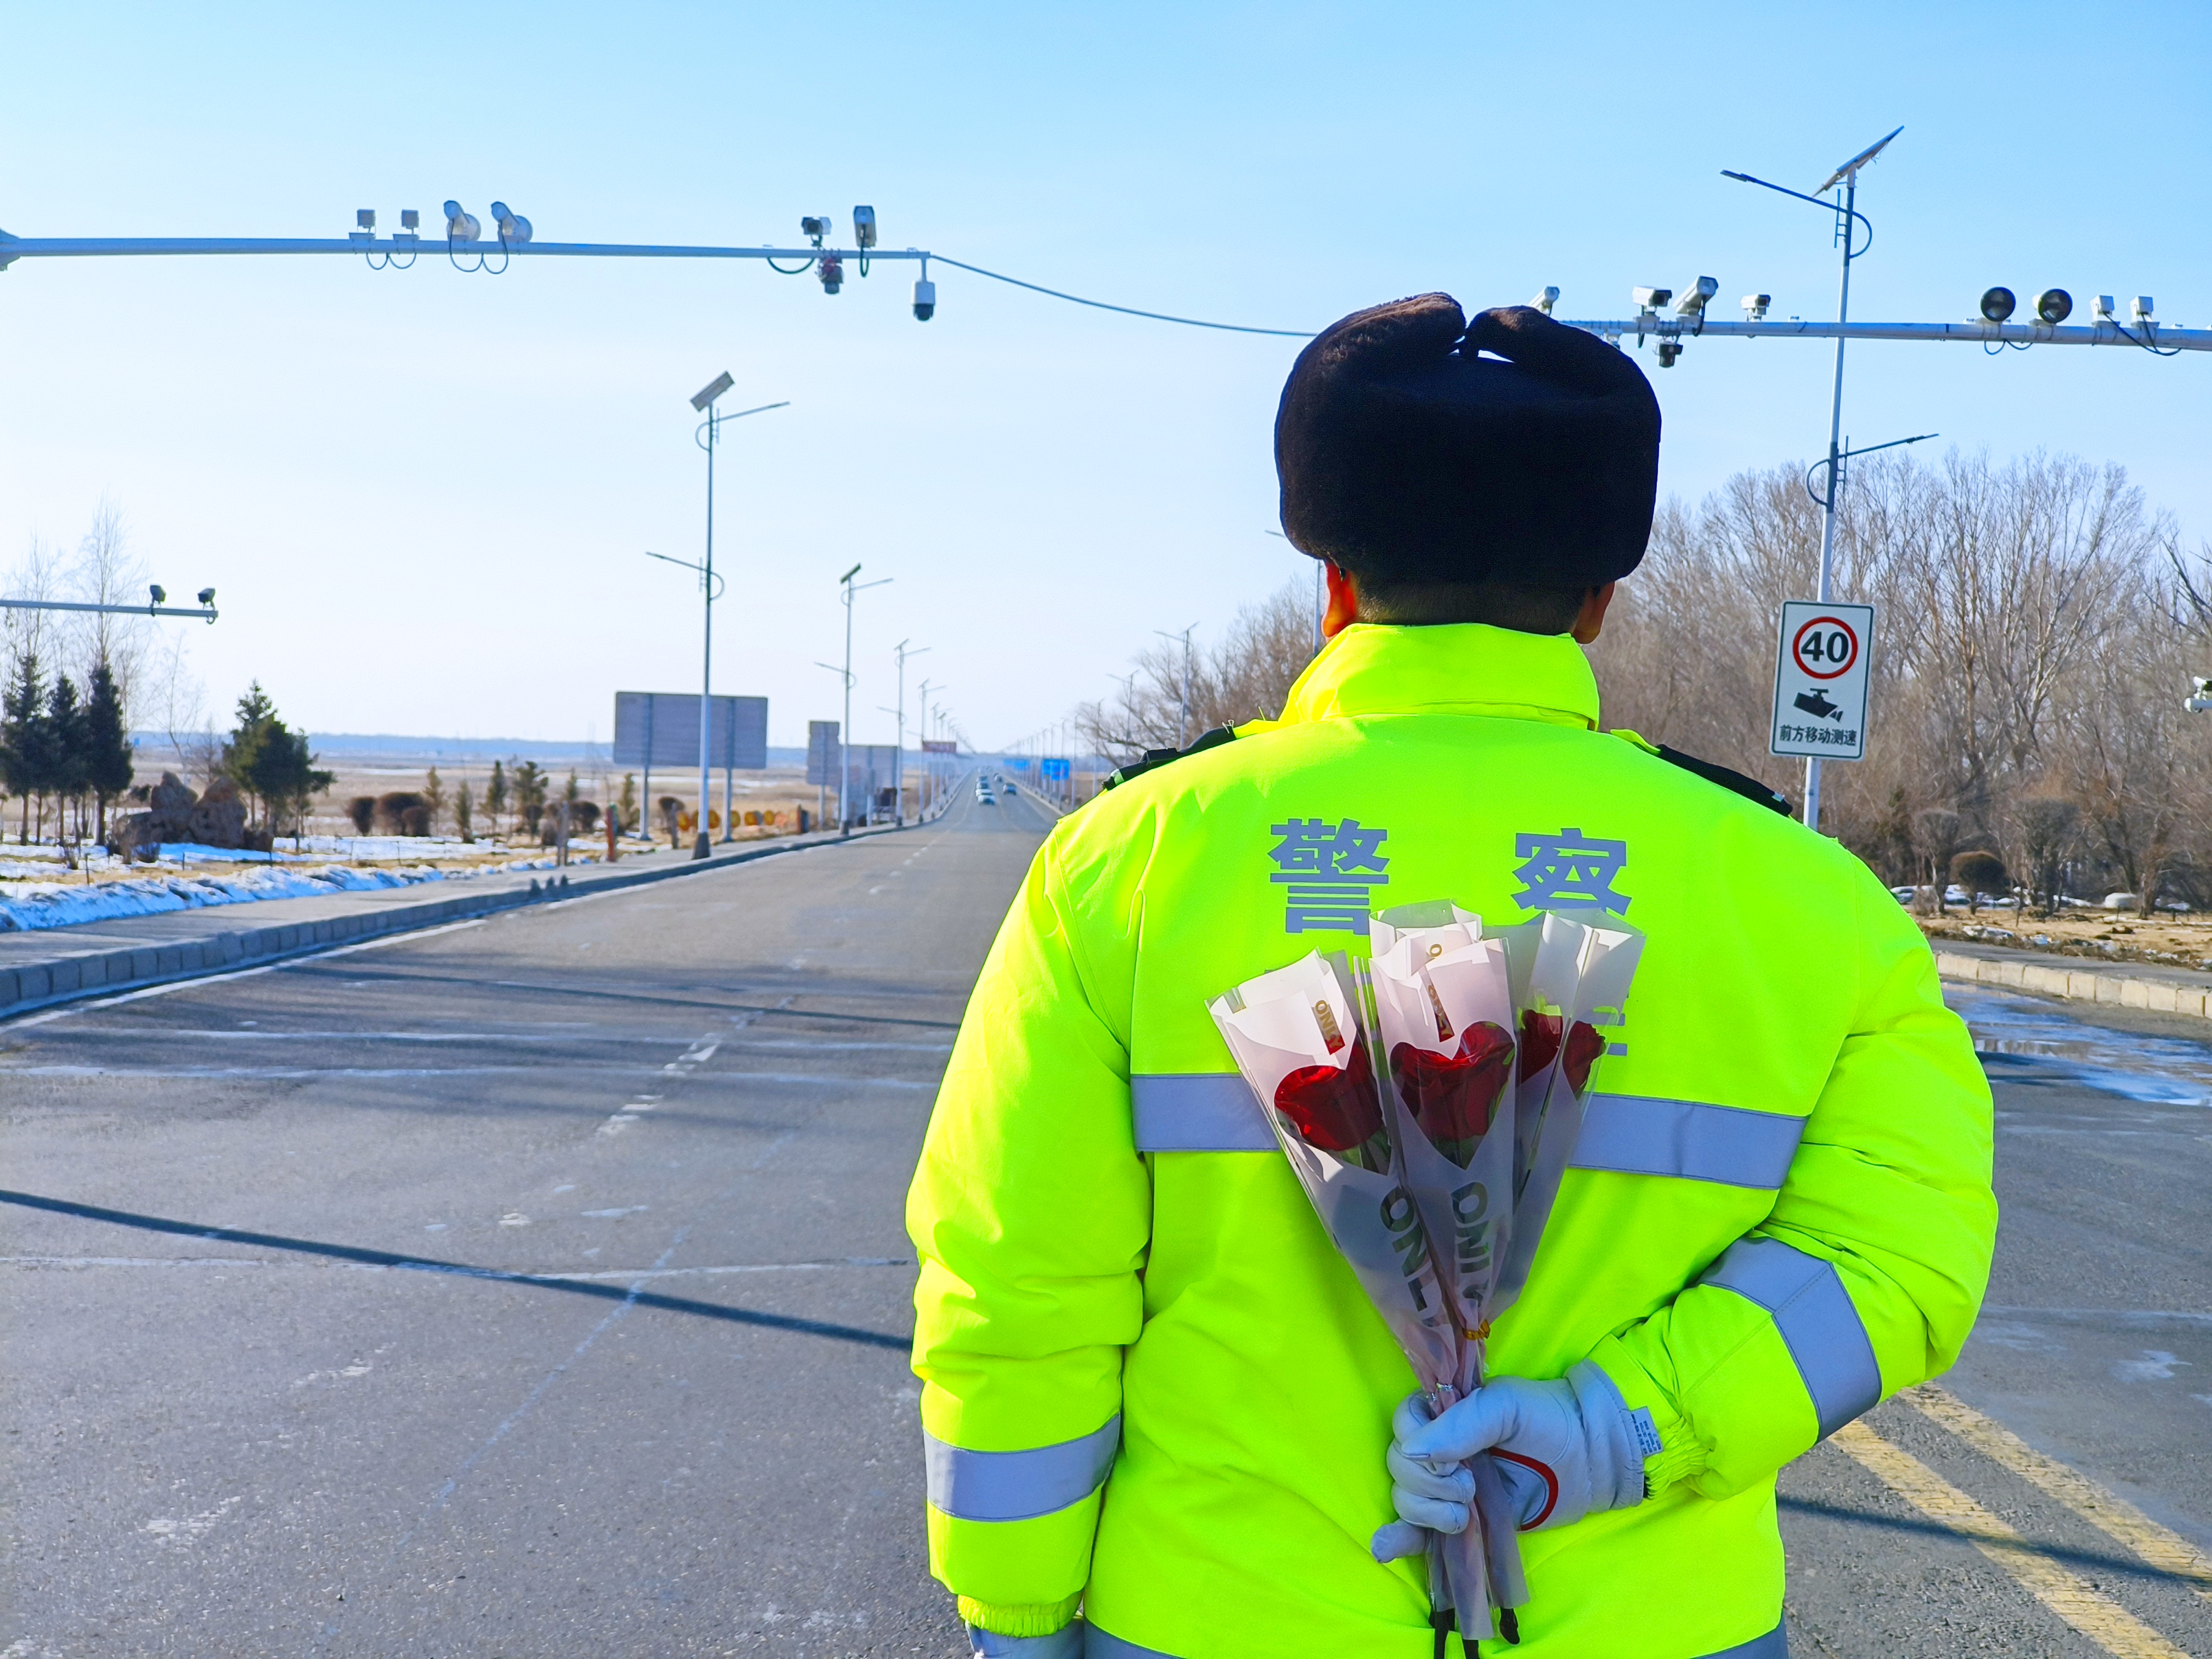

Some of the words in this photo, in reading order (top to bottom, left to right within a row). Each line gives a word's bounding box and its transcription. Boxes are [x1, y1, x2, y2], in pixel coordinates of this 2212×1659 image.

[1801, 631, 1849, 663] 40
[1780, 724, 1857, 746] 前方移动测速
[1315, 1000, 1343, 1048] ONLY
